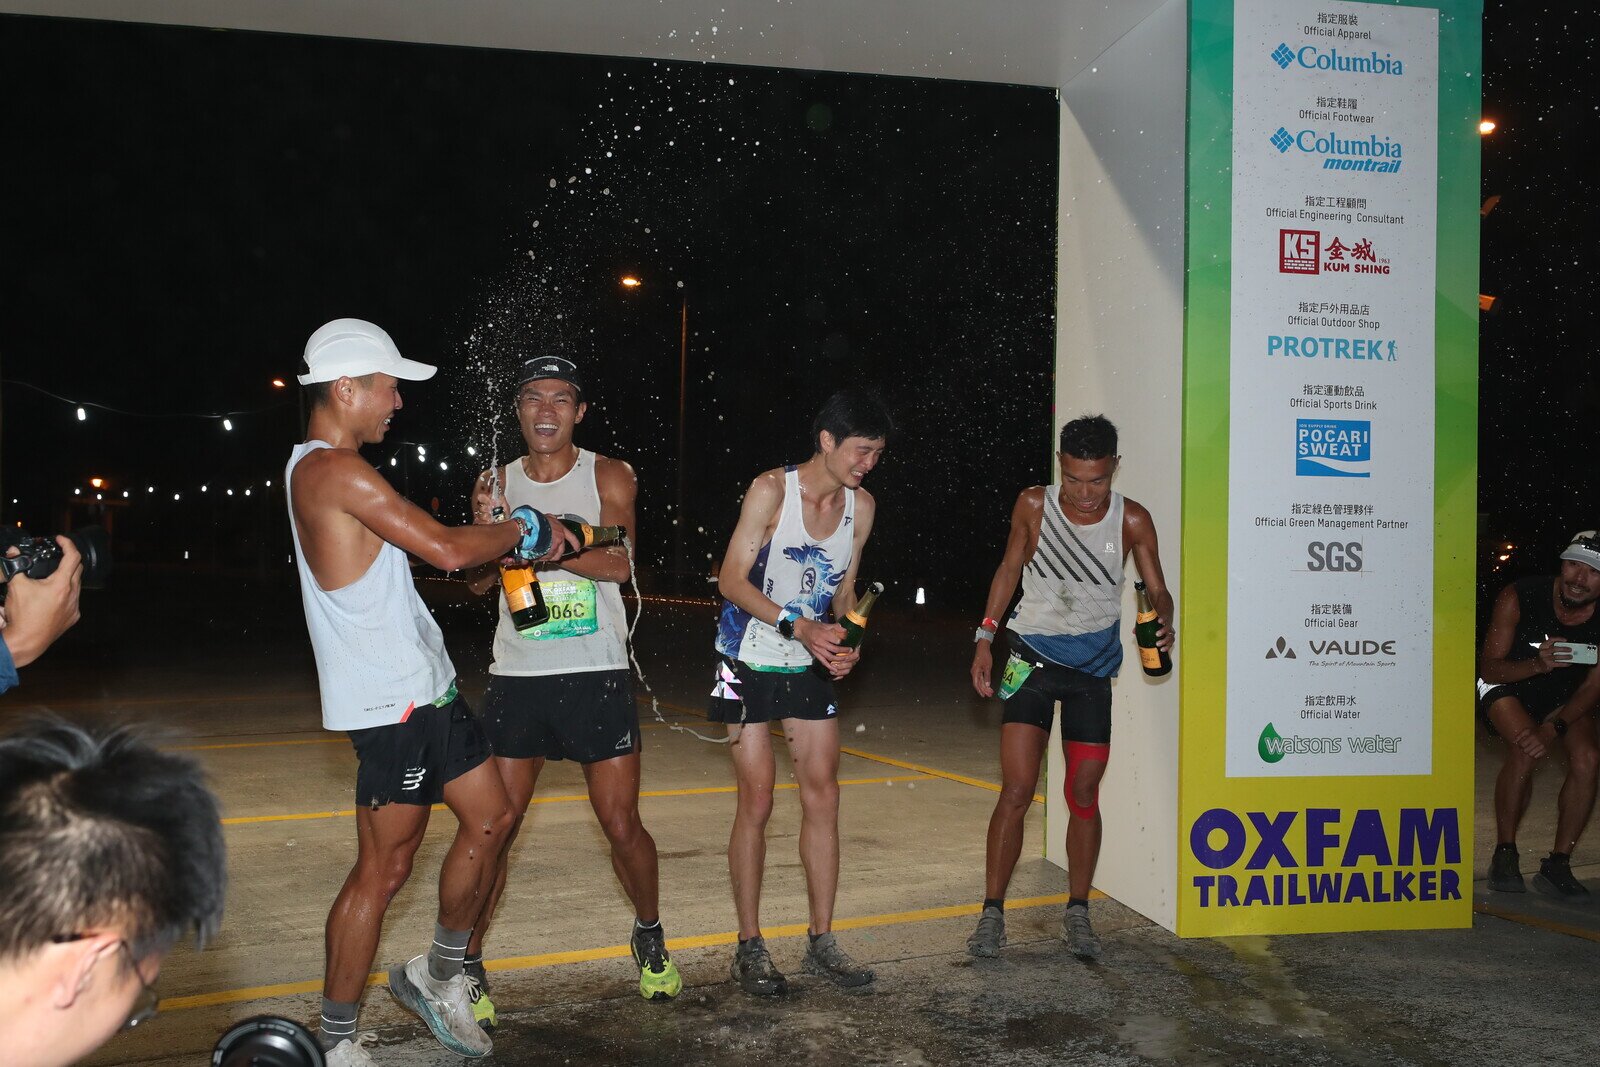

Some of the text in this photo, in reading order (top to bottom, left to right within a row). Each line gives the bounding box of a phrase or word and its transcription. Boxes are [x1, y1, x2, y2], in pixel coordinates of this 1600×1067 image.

[1317, 12, 1358, 26] 指定服裝
[1304, 25, 1372, 40] Official Apparel
[1297, 46, 1403, 75] Columbia
[1316, 96, 1358, 110] 指定鞋履
[1299, 109, 1375, 124] Official Footwear
[1296, 130, 1402, 158] Columbia
[1323, 158, 1402, 174] montrail
[1304, 195, 1367, 210] 指定工程顧問
[1266, 207, 1405, 225] Official Engineering Consultant
[1284, 233, 1316, 259] KS
[1324, 236, 1376, 263] 金城
[1324, 262, 1390, 275] KUM SHING
[1298, 301, 1370, 316] 指定戶外用品店
[1287, 315, 1380, 331] Official Outdoor Shop
[1267, 335, 1383, 361] PROTREK
[1303, 384, 1365, 397] 指定運動飲品
[1290, 398, 1378, 411] Official Sports Drink
[1299, 429, 1368, 443] POCARI
[1299, 442, 1362, 456] SWEAT
[1291, 503, 1374, 516] 指定綠色管理夥伴
[1255, 517, 1409, 530] Official Green Management Partner
[1307, 541, 1363, 572] SGS
[1310, 603, 1353, 616] 指定裝備
[1304, 618, 1359, 628] Official Gear
[1309, 640, 1396, 655] VAUDE
[1304, 695, 1357, 707] 指定飲用水
[1300, 710, 1361, 719] Official Water
[1348, 734, 1402, 754] water
[1190, 808, 1462, 870] OXFAM
[1193, 869, 1463, 908] TRAILWALKER
